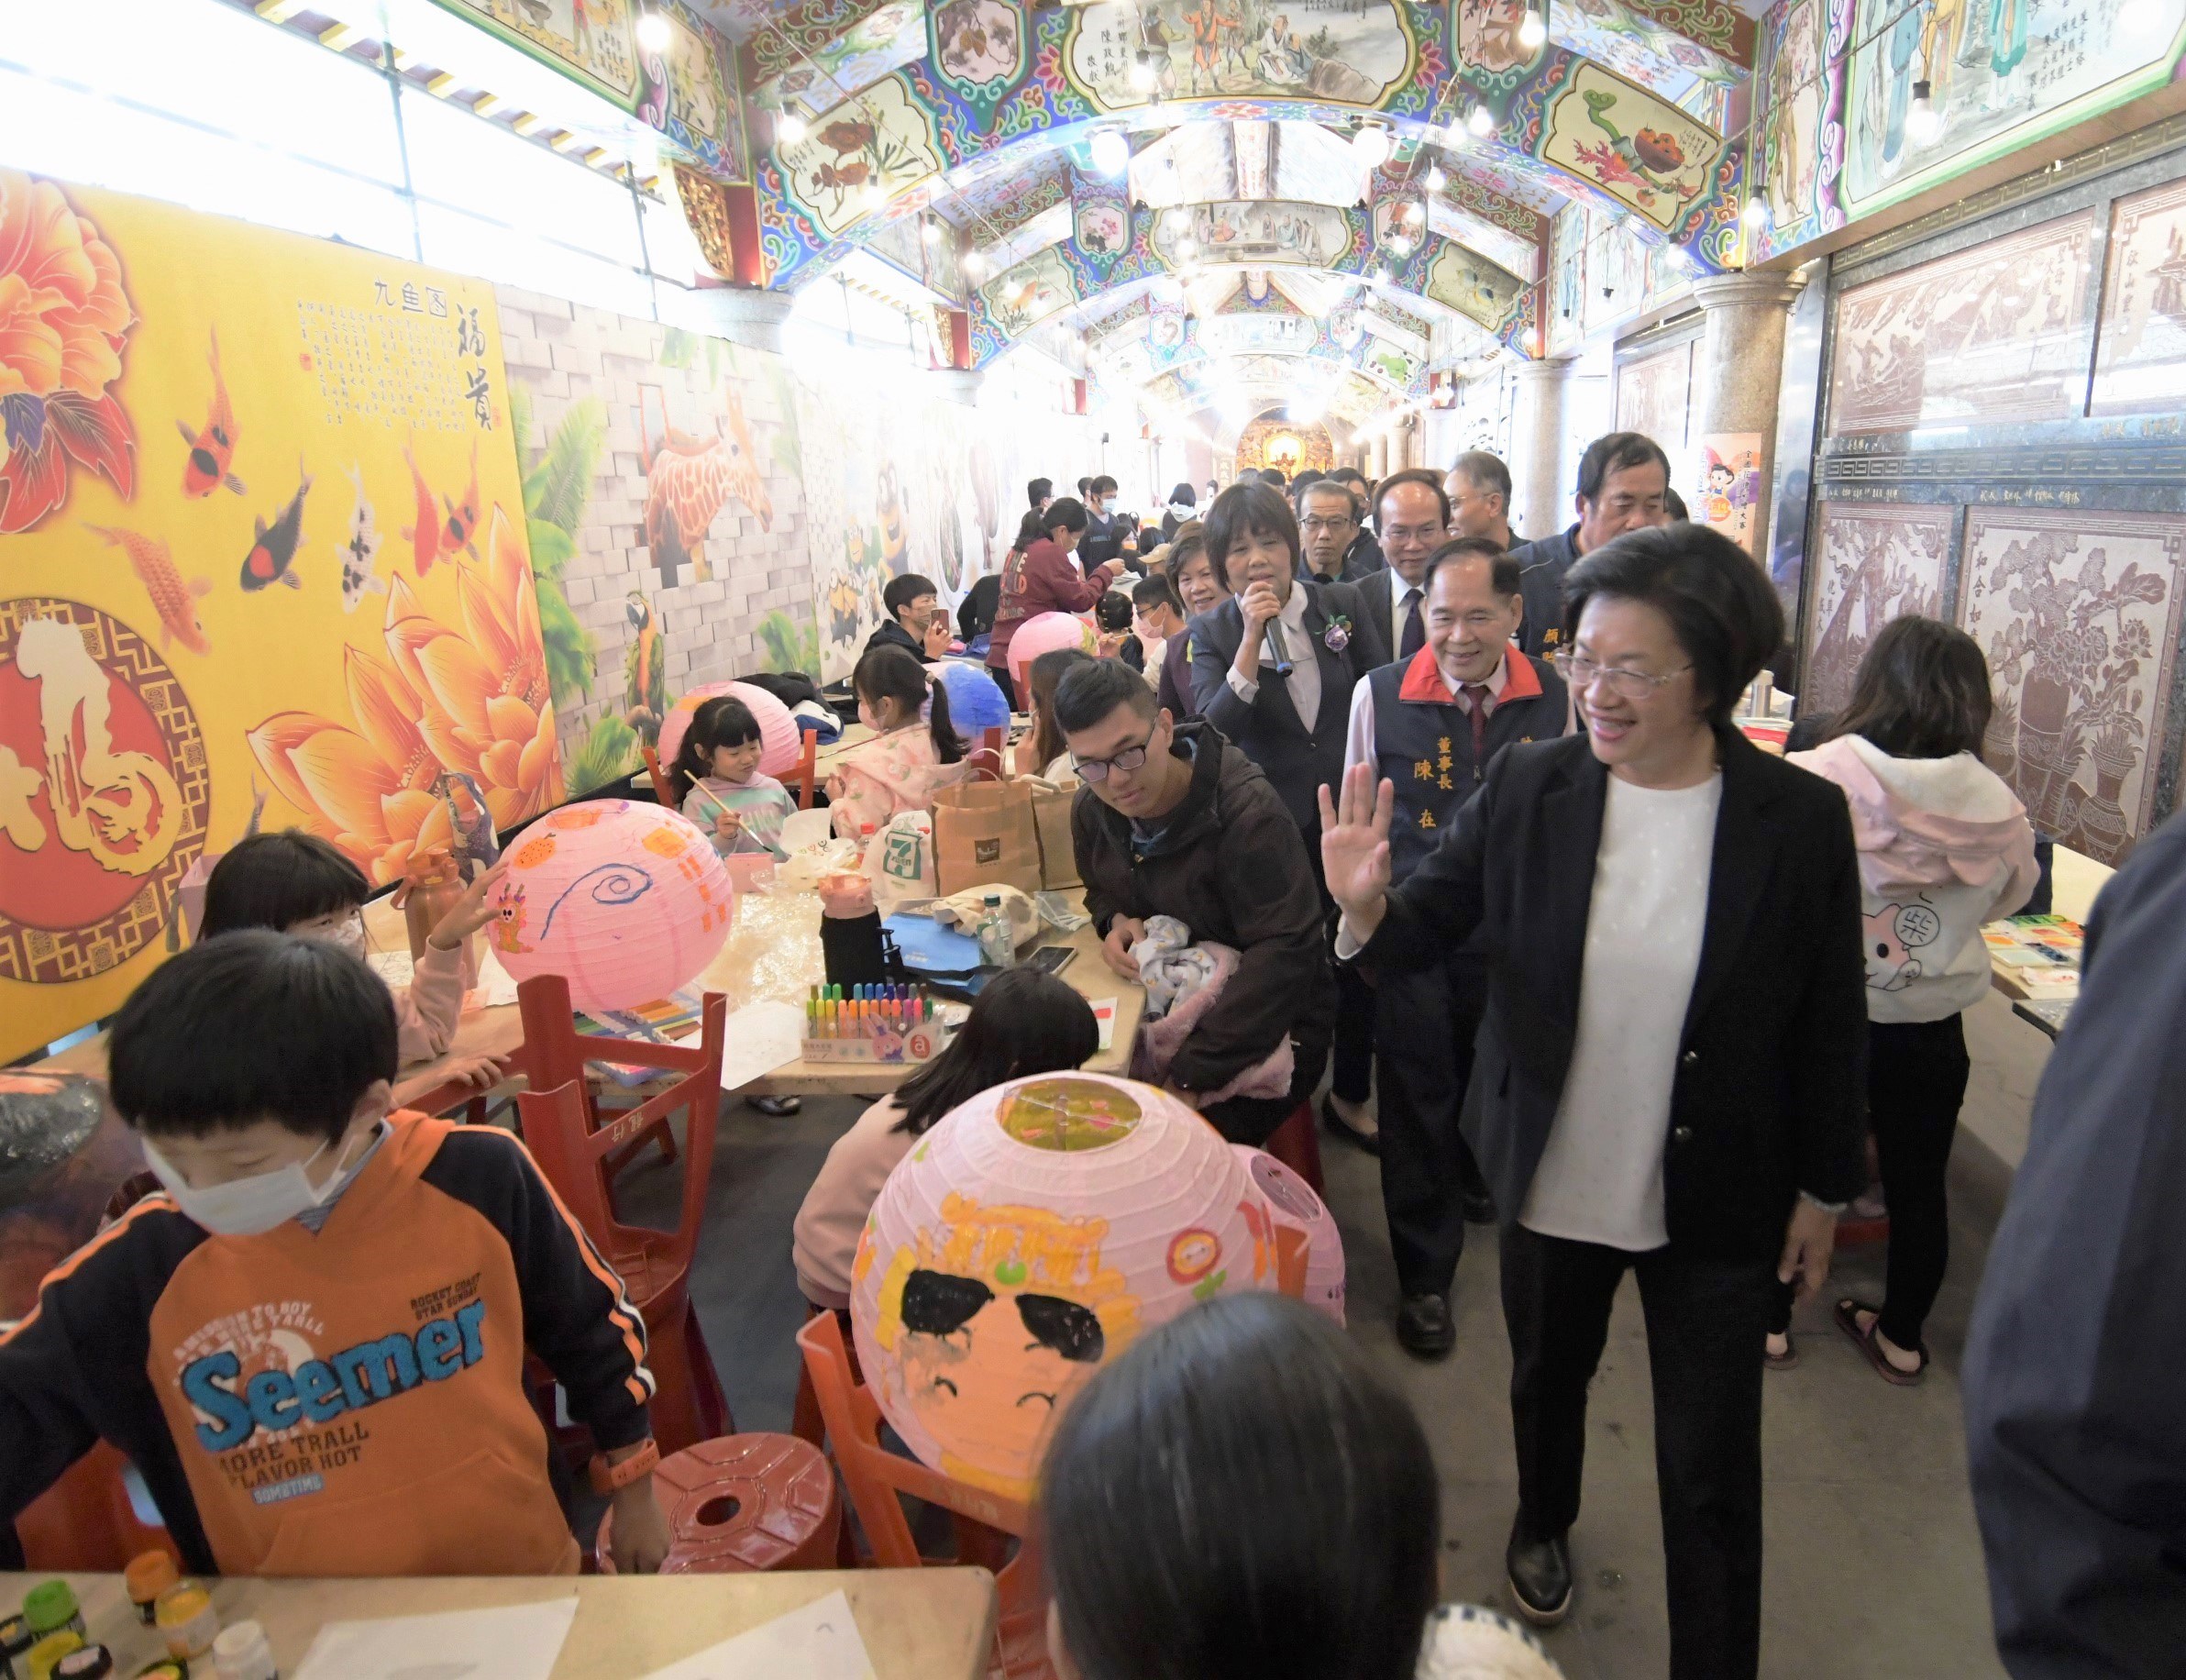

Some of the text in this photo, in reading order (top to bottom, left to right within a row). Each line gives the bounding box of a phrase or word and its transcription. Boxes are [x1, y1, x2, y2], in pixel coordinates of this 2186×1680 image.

[374, 282, 447, 317] 九鱼图
[1437, 736, 1453, 790] 董事長
[1414, 759, 1436, 829] 陳 在
[415, 1302, 443, 1321] STAR
[182, 1299, 485, 1452] Seemer
[291, 1421, 370, 1455] TRALL
[319, 1445, 361, 1469] HOT
